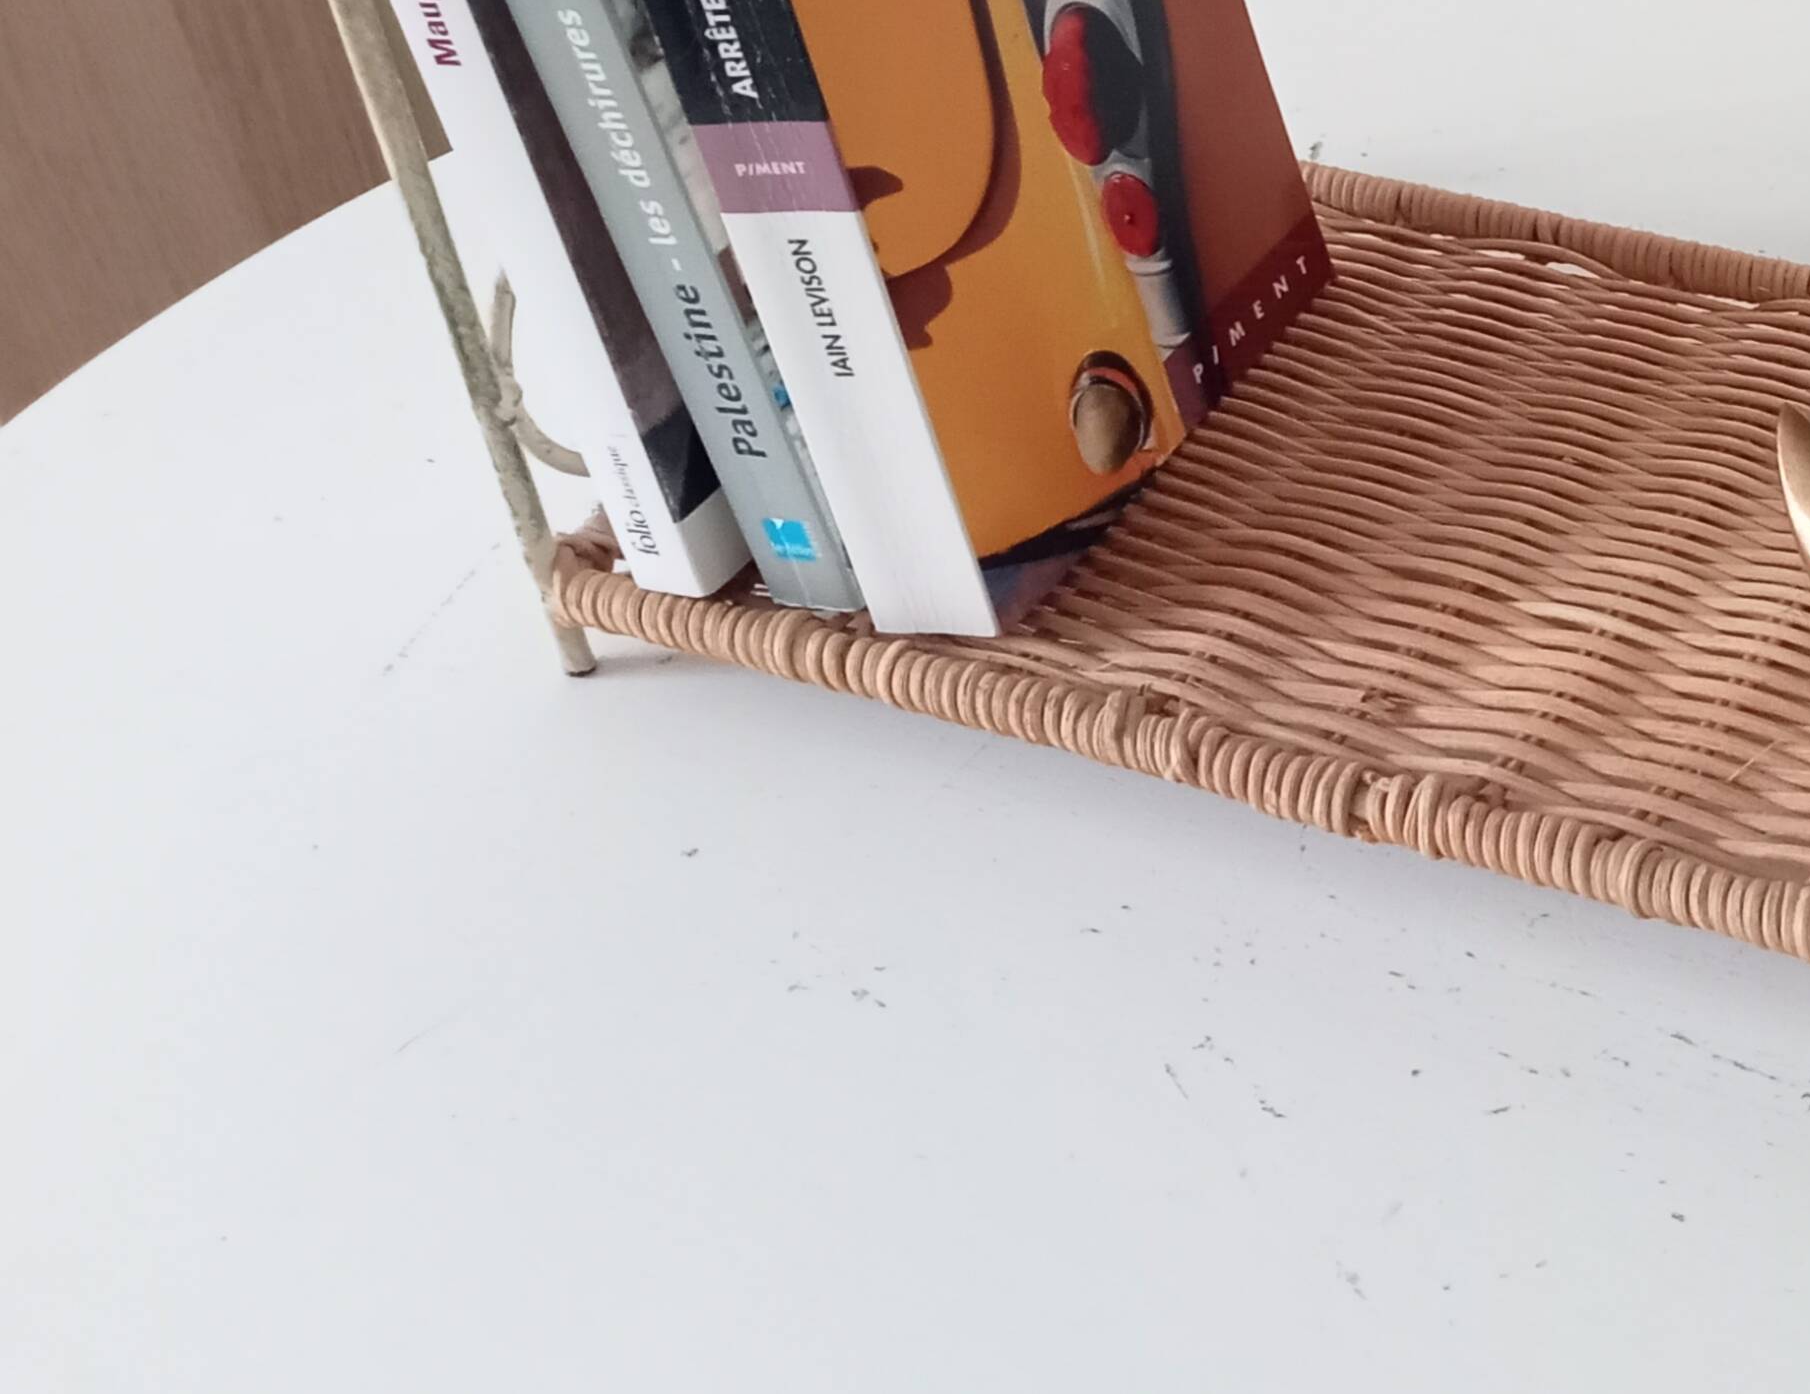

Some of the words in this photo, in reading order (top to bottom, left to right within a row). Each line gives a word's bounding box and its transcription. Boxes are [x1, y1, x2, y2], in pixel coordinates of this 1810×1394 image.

[558, 8, 651, 189] déchirures
[734, 159, 806, 178] PIMENT
[647, 198, 678, 248] les
[787, 238, 837, 328] LEVISON
[1193, 256, 1307, 384] PIMENT
[671, 283, 768, 461] Palestine
[821, 335, 854, 380] IAIN
[626, 510, 660, 556] folio
